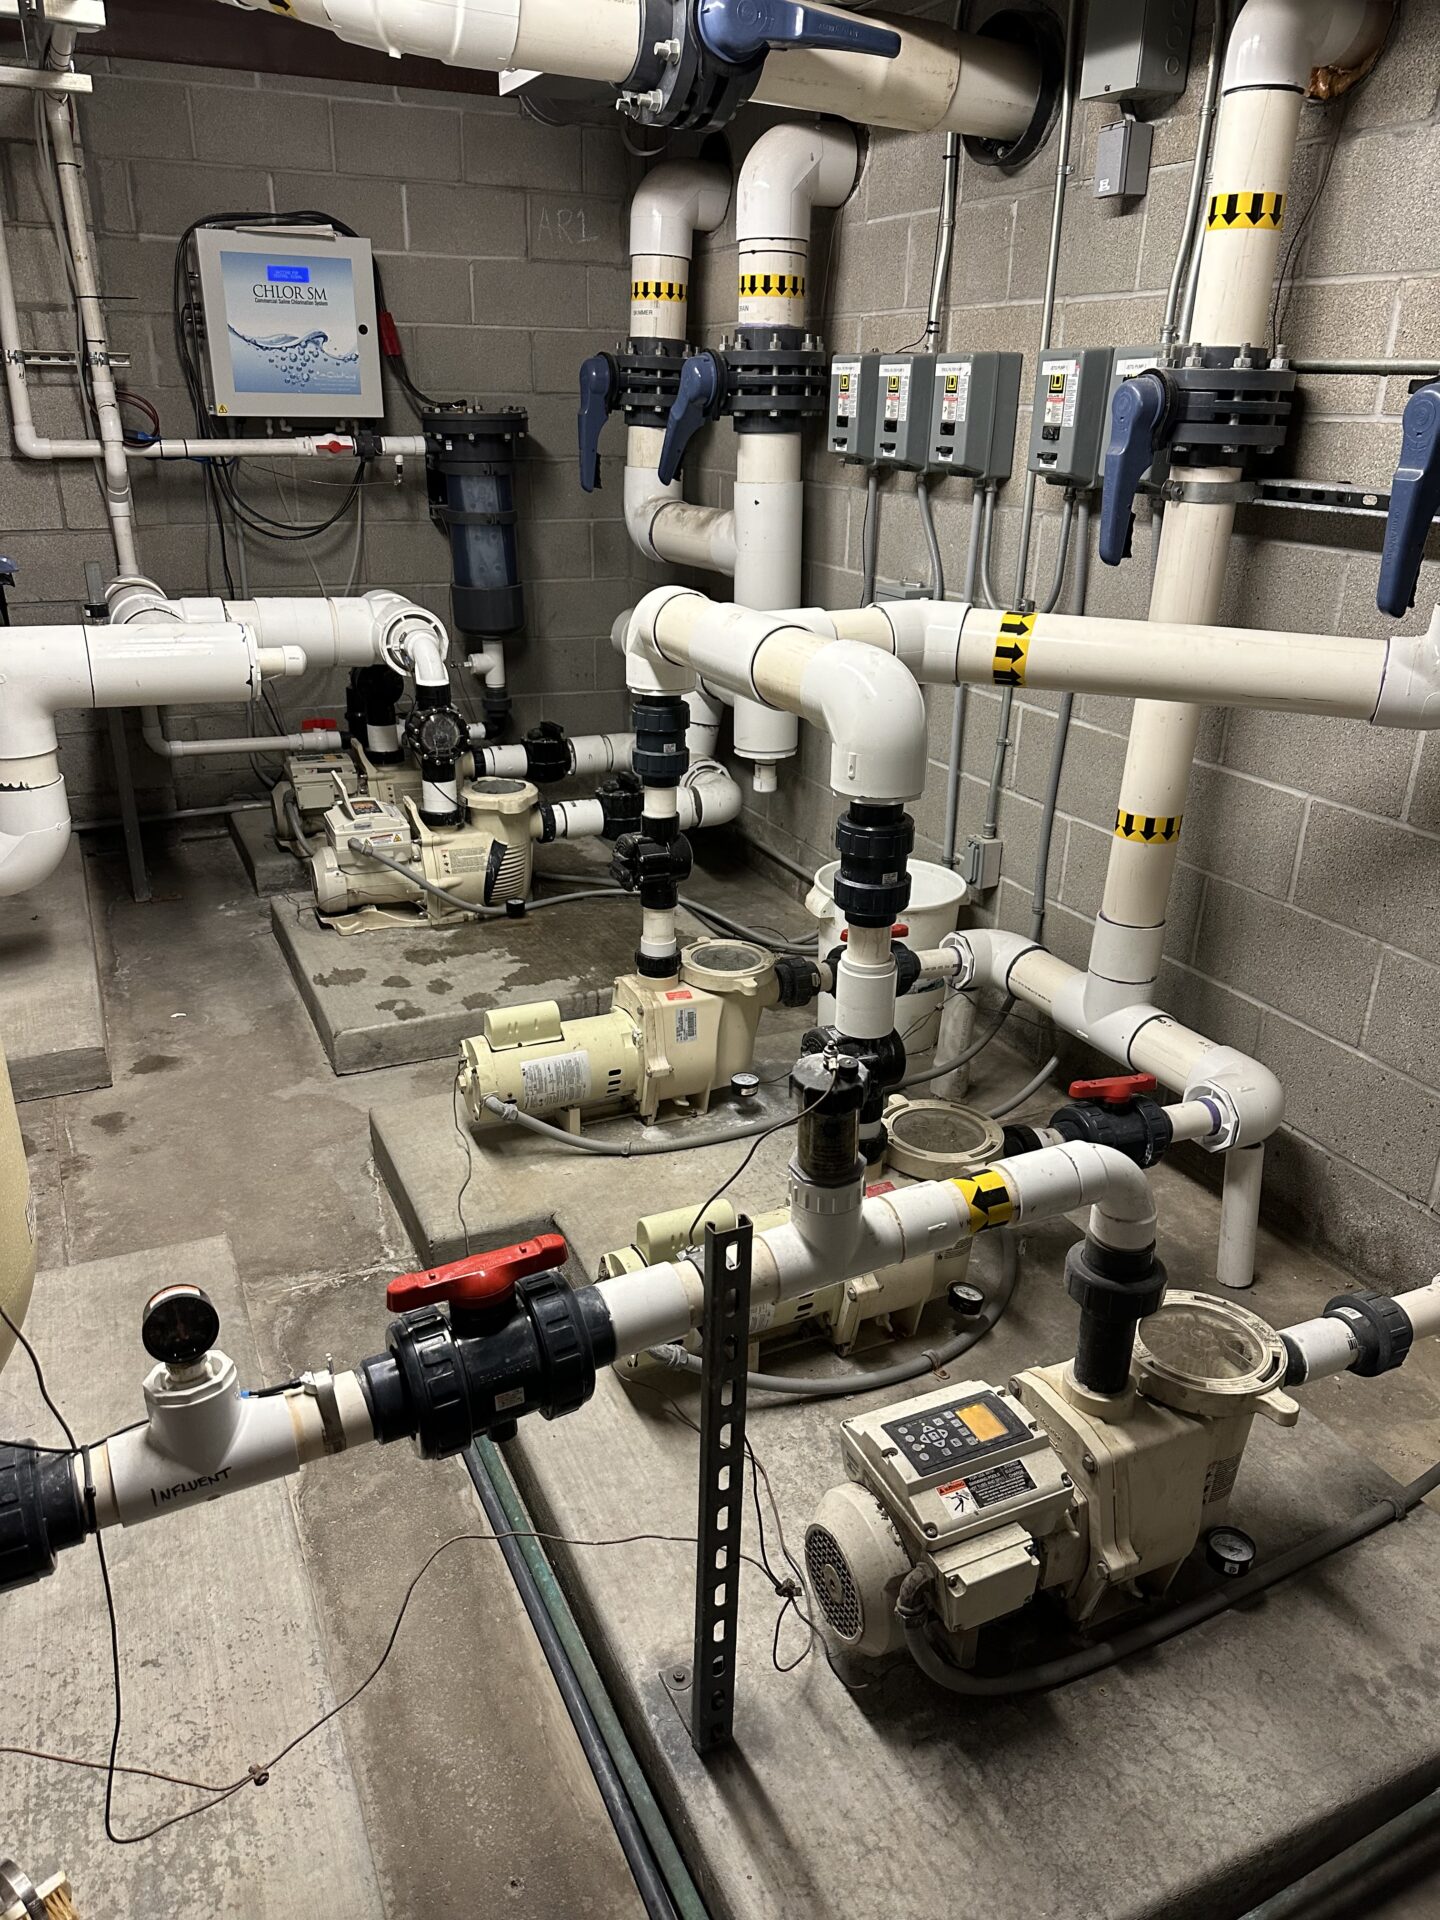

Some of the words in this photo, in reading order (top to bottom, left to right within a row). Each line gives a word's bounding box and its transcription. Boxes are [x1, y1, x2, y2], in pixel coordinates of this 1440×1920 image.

[252, 284, 305, 300] CHLOR
[307, 286, 328, 301] SM
[150, 1466, 232, 1507] INFLUENT
